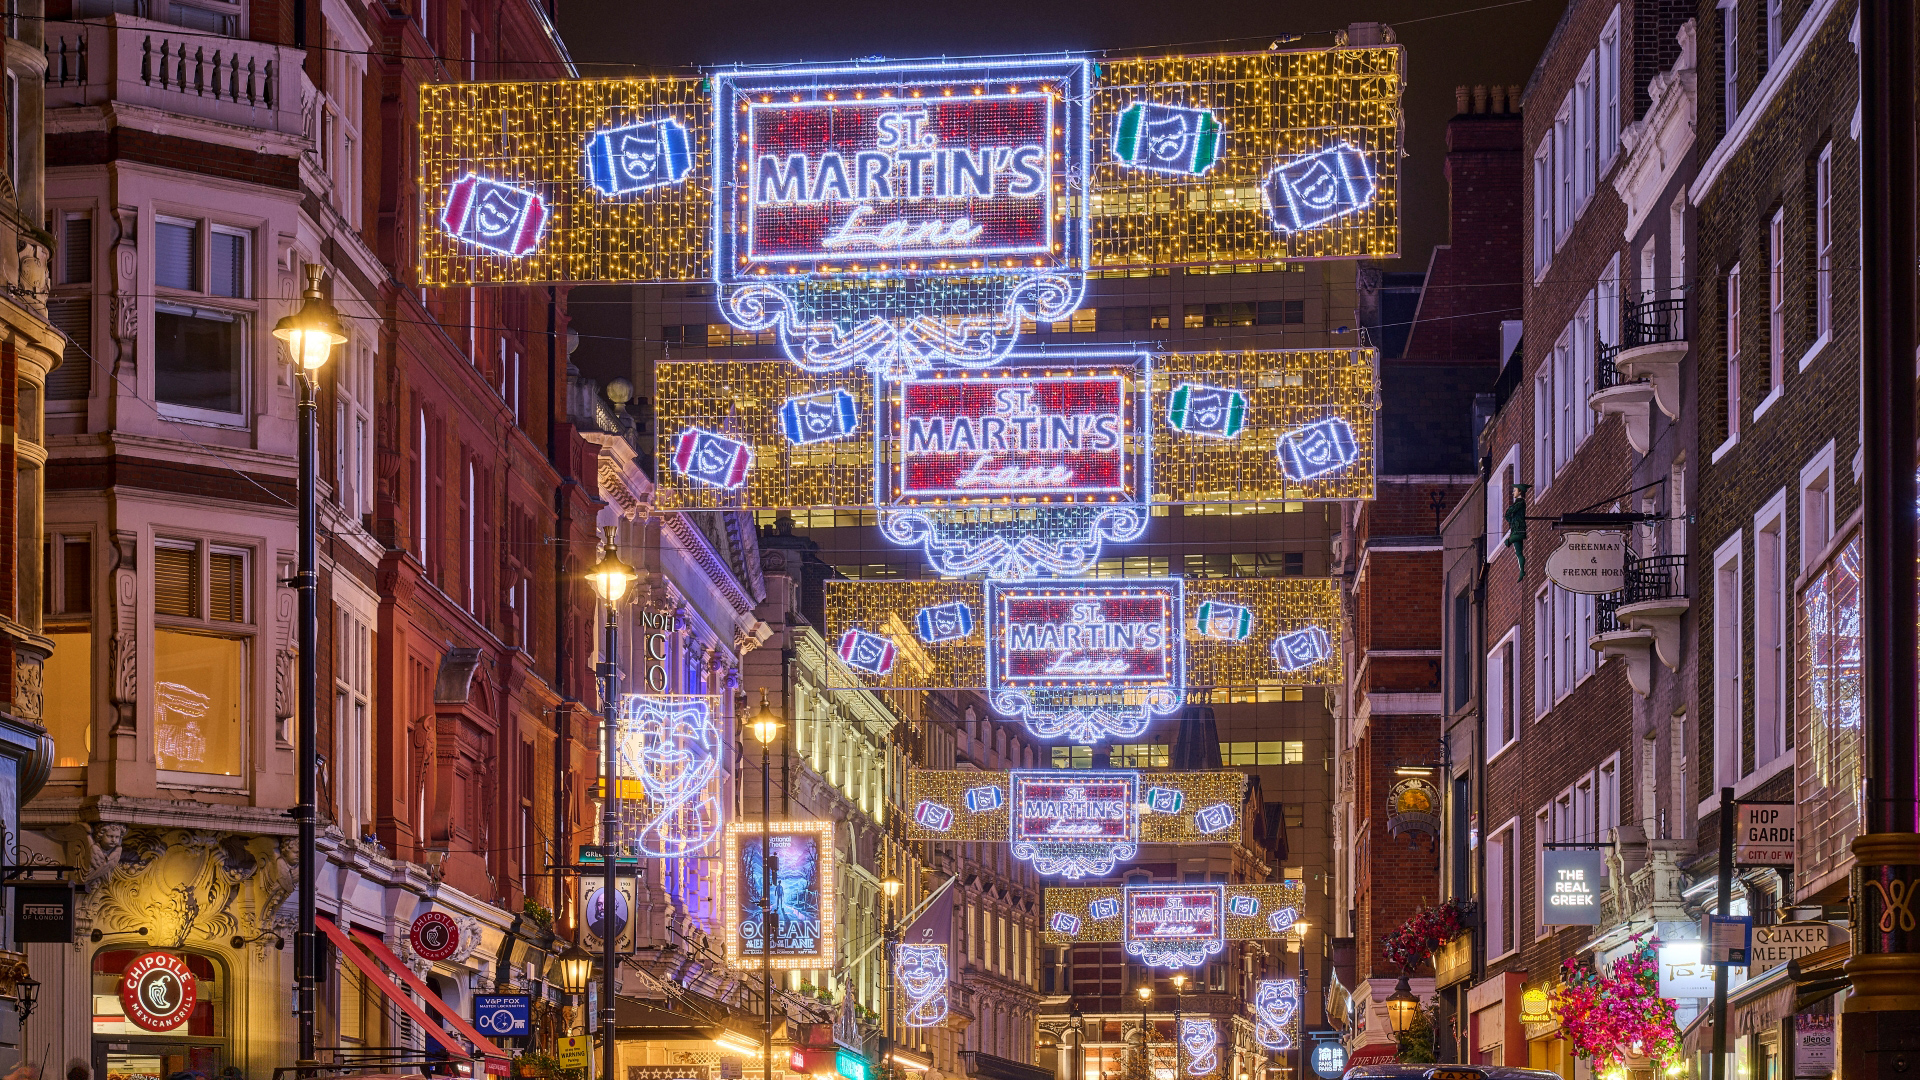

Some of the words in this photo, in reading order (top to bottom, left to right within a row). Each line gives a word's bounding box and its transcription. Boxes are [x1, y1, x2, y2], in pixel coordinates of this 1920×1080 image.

[877, 111, 937, 149] ST.
[757, 145, 1048, 203] MARTIN'S
[822, 205, 983, 247] Lane
[996, 388, 1040, 414] ST.
[907, 414, 1120, 452] MARTIN'S
[956, 455, 1074, 487] Lane
[1590, 556, 1598, 564] &
[1073, 603, 1105, 622] ST.
[1010, 622, 1162, 649] MARTIN'S
[1045, 651, 1130, 673] Lane
[1025, 800, 1124, 819] MARTIN'S
[1750, 809, 1779, 824] HOP
[1749, 827, 1795, 842] GARDE
[1748, 851, 1767, 860] CITY
[1771, 851, 1782, 860] OF
[1785, 851, 1794, 860] W
[1558, 869, 1584, 880] THE
[1556, 882, 1590, 893] REAL
[1551, 894, 1593, 906] GREEK
[23, 903, 64, 915] FREED
[1135, 907, 1213, 922] MARTIN'S
[413, 913, 457, 934] CHIPOTLE
[586, 932, 598, 945] THE
[785, 939, 815, 949] LANE
[1756, 928, 1827, 945] QUAKER
[413, 940, 440, 958] MEXICAN
[440, 940, 456, 958] GRILL
[126, 955, 191, 989] CHIPOTLE
[131, 1002, 173, 1028] MEXICAN
[173, 996, 193, 1024] GRILL
[1803, 1035, 1831, 1043] silence
[561, 1050, 585, 1058] WARNING
[1352, 1056, 1372, 1066] THE
[1437, 1072, 1477, 1080] TAXI
